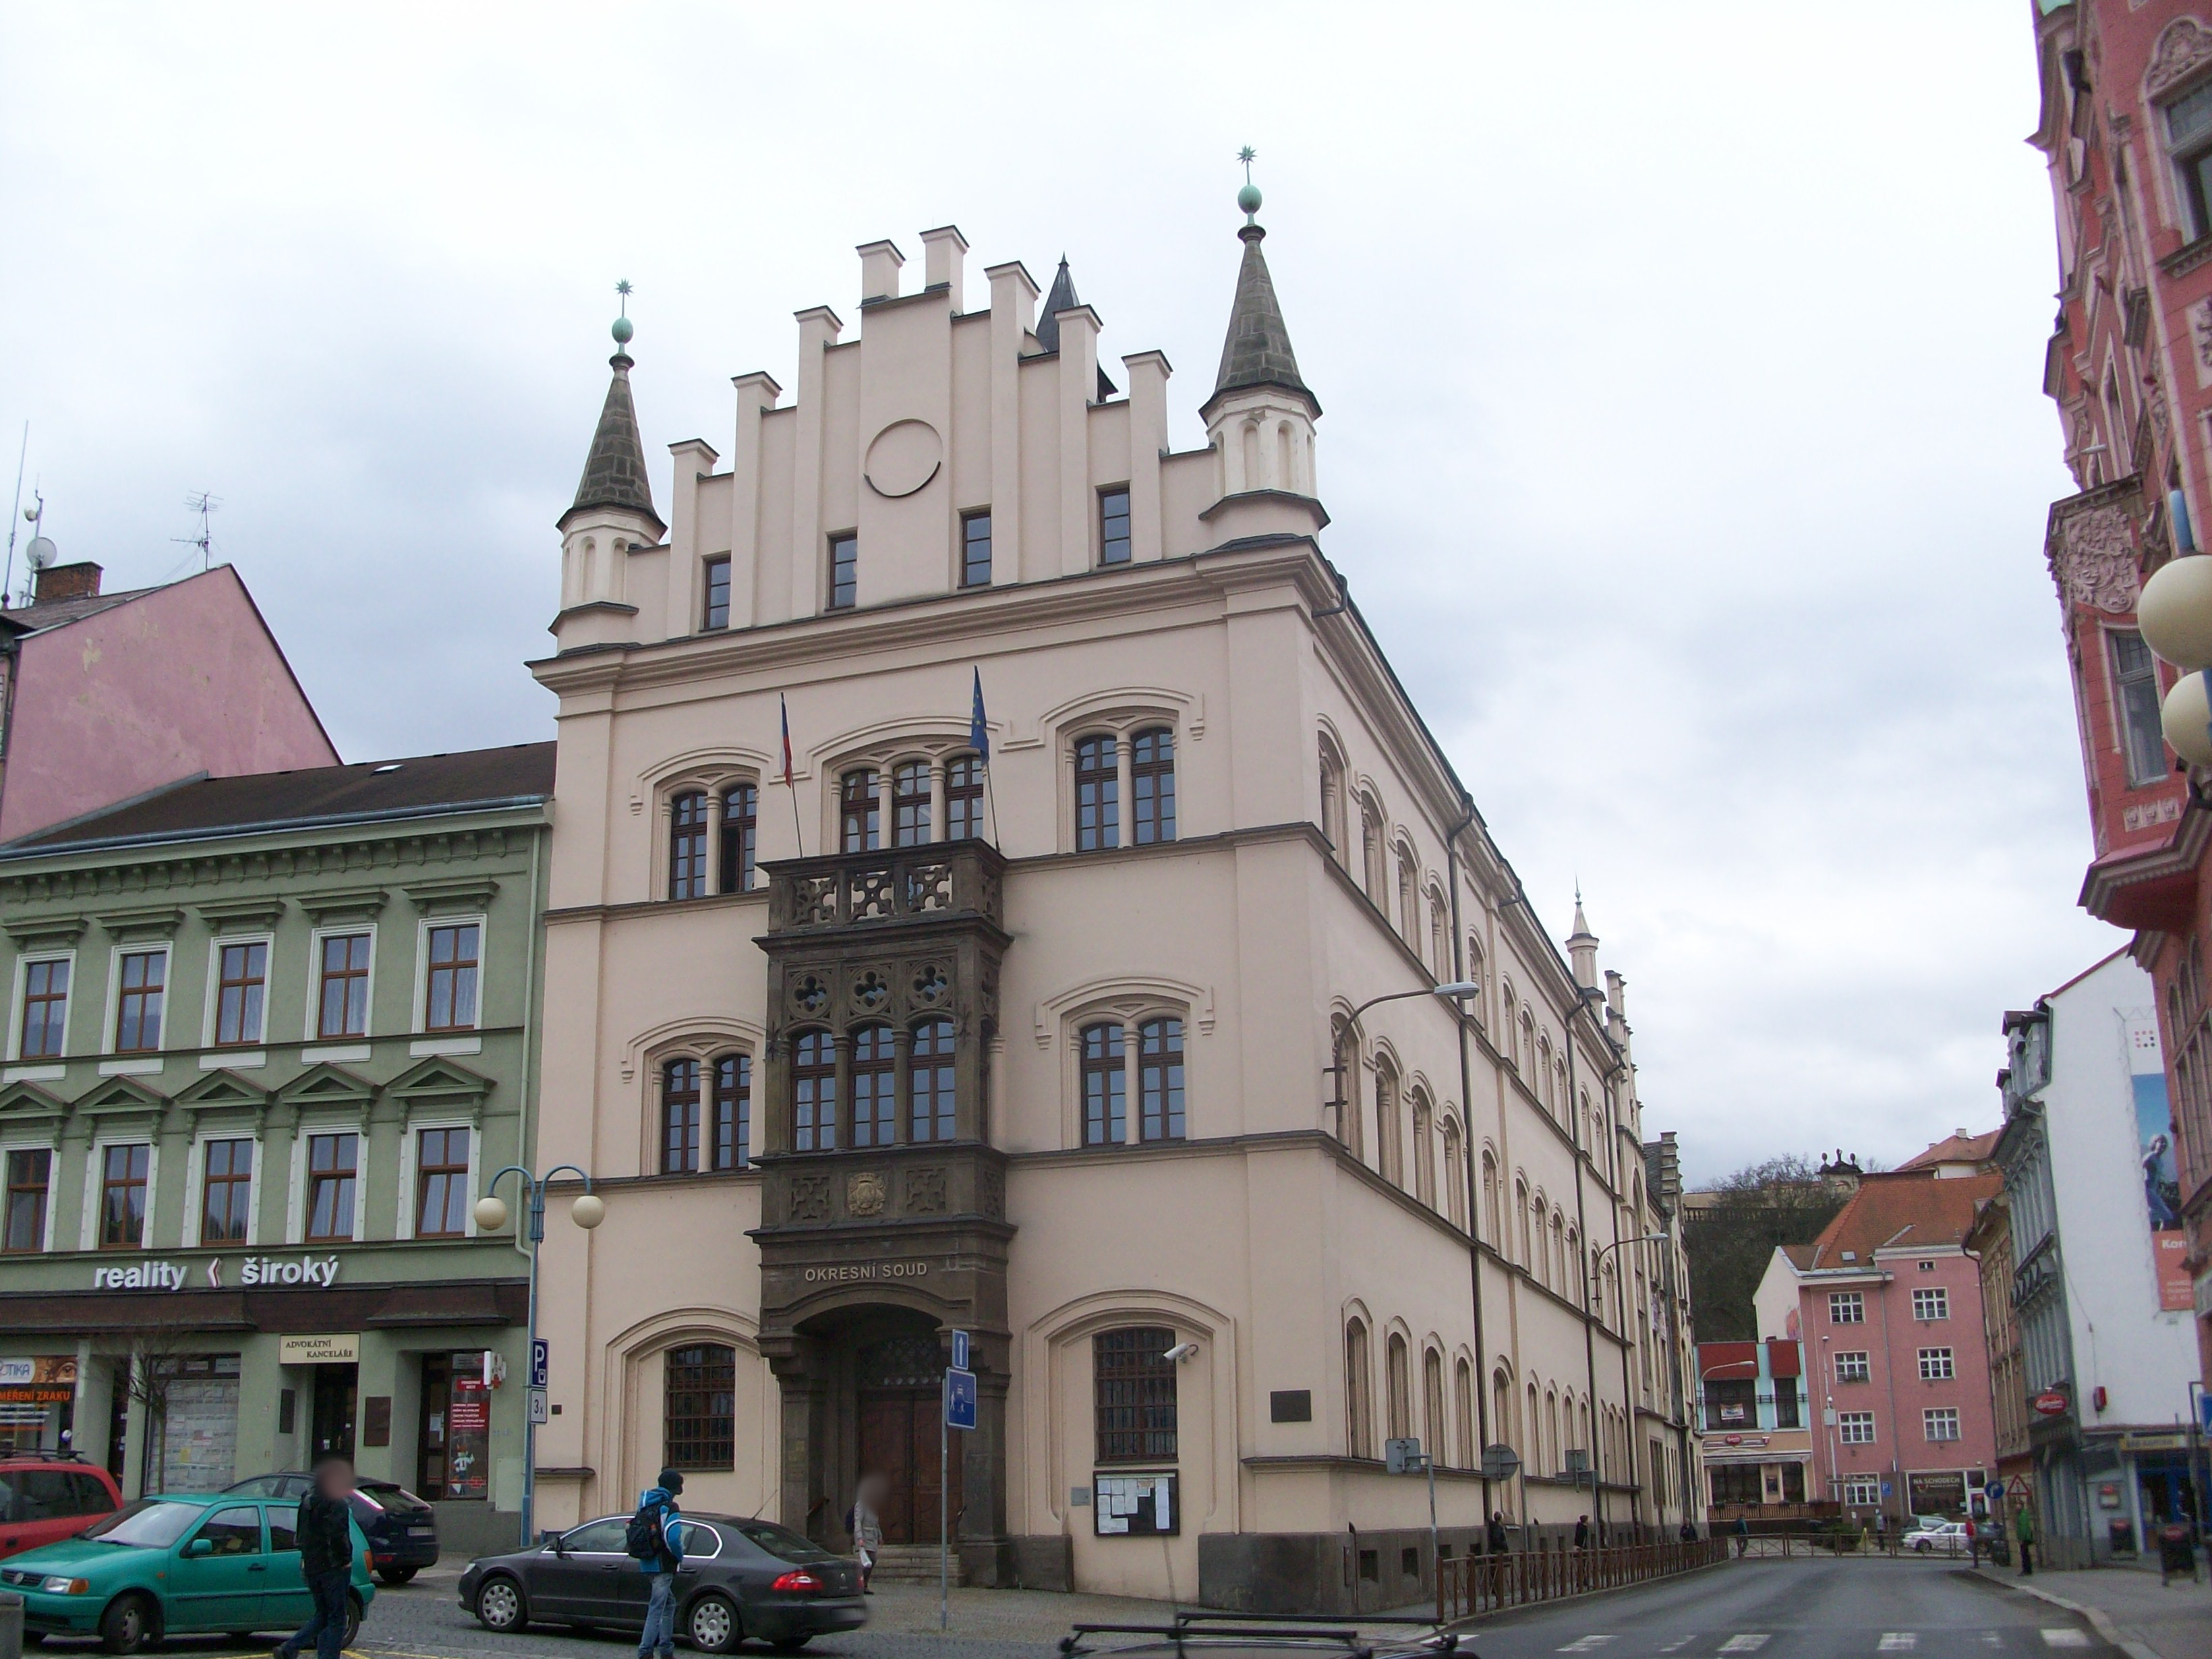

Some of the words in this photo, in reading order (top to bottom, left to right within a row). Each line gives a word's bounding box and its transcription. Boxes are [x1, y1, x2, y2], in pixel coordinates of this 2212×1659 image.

[94, 1261, 187, 1291] reality
[241, 1256, 339, 1287] široký
[805, 1262, 877, 1281] OKRESNÍ
[882, 1262, 928, 1277] SOUD
[285, 1339, 331, 1348] ADVOKÁTNÍ
[307, 1349, 353, 1358] KANCELÁŘE
[534, 1344, 545, 1372] P
[36, 1391, 71, 1401] ZRAKU
[1882, 1483, 1889, 1491] P
